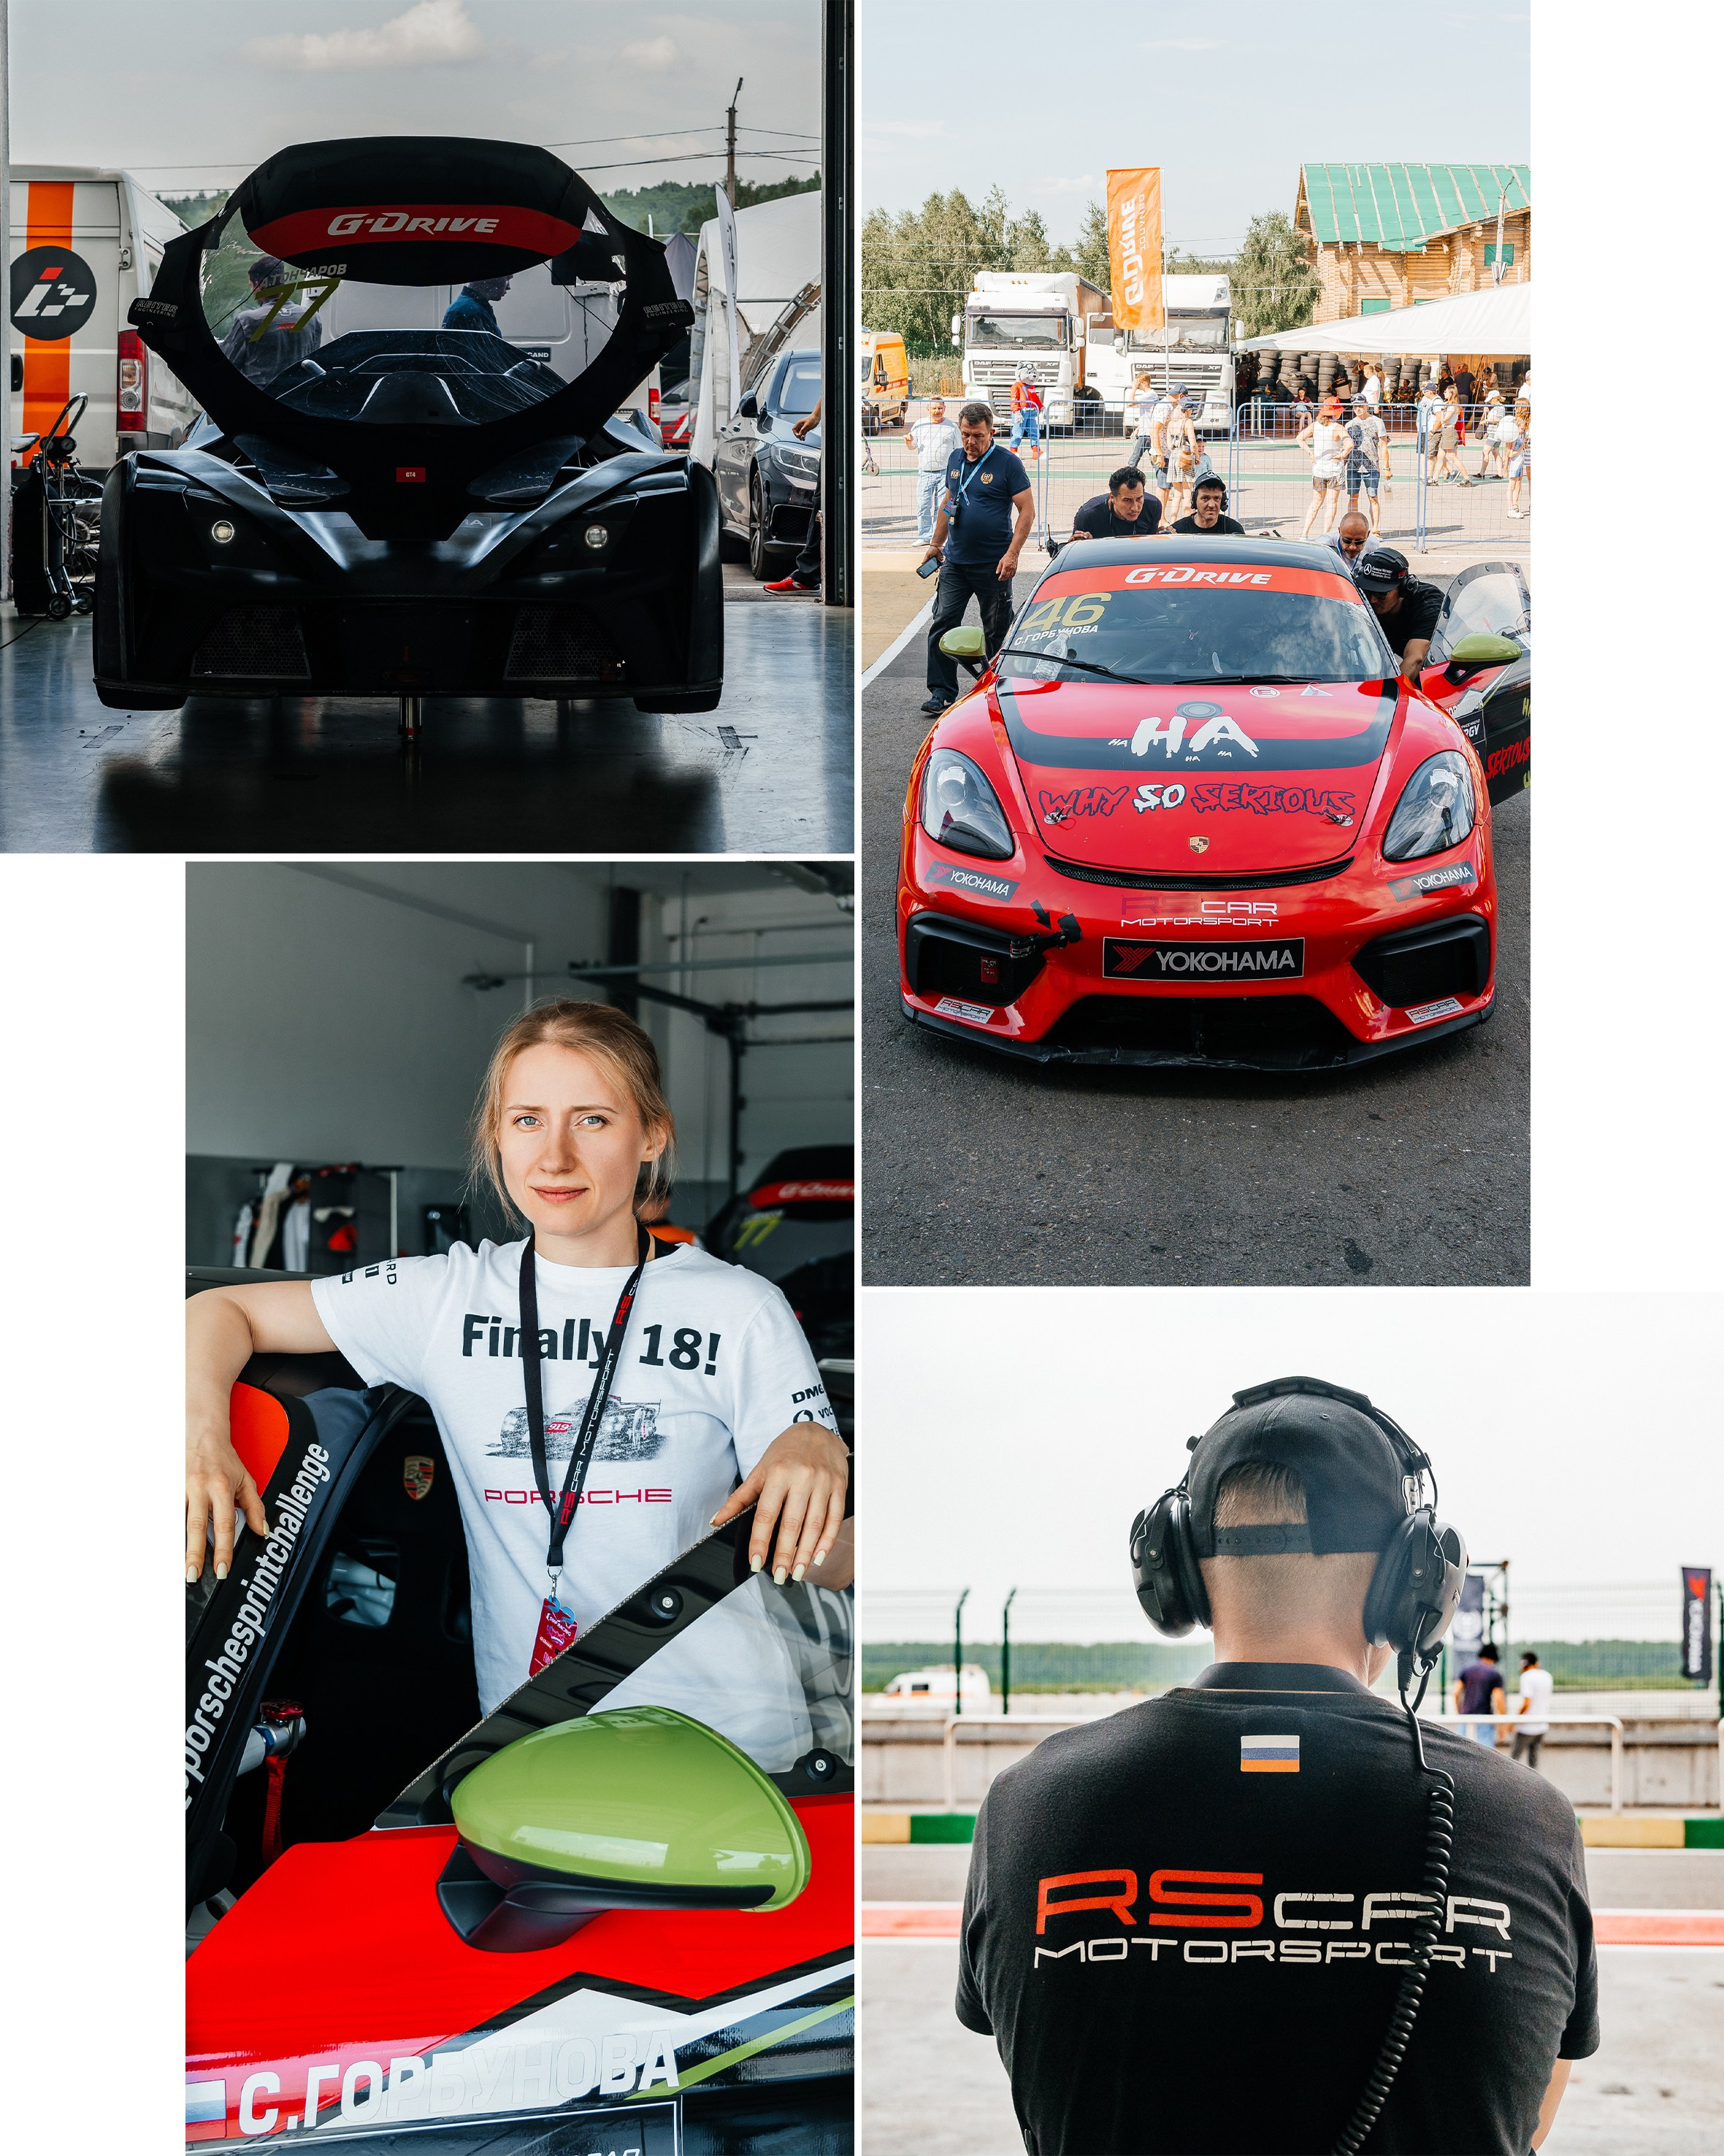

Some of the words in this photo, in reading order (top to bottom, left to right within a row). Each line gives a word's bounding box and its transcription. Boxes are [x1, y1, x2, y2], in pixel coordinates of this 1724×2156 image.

[327, 212, 500, 236] G-DRIVE
[134, 307, 176, 318] ENGINEERING
[136, 299, 178, 314] REITER
[248, 277, 342, 343] 77
[643, 301, 686, 314] REITER
[646, 309, 689, 318] ENGINEERING
[1125, 567, 1273, 585] G-DRIVE
[1019, 592, 1112, 632] 46
[1108, 738, 1128, 748] HA
[1130, 716, 1260, 758] HA
[1038, 786, 1129, 817] WHY
[1132, 783, 1187, 813] SO
[1190, 783, 1357, 817] SERIOUS
[950, 870, 1010, 896] YOKOHAMA
[1413, 866, 1473, 890] YOKOHAMA
[1121, 917, 1279, 927] MOTORSPORT
[1155, 949, 1296, 972] YOKOHAMA
[639, 1324, 721, 1376] 18!
[580, 1349, 616, 1456] MOTORSPORT
[548, 1423, 570, 1432] 919
[557, 1623, 572, 1637] RACING
[1034, 1937, 1513, 1973] MOTORSPORT
[239, 2029, 680, 2136] С.ГОРБУНОВА
